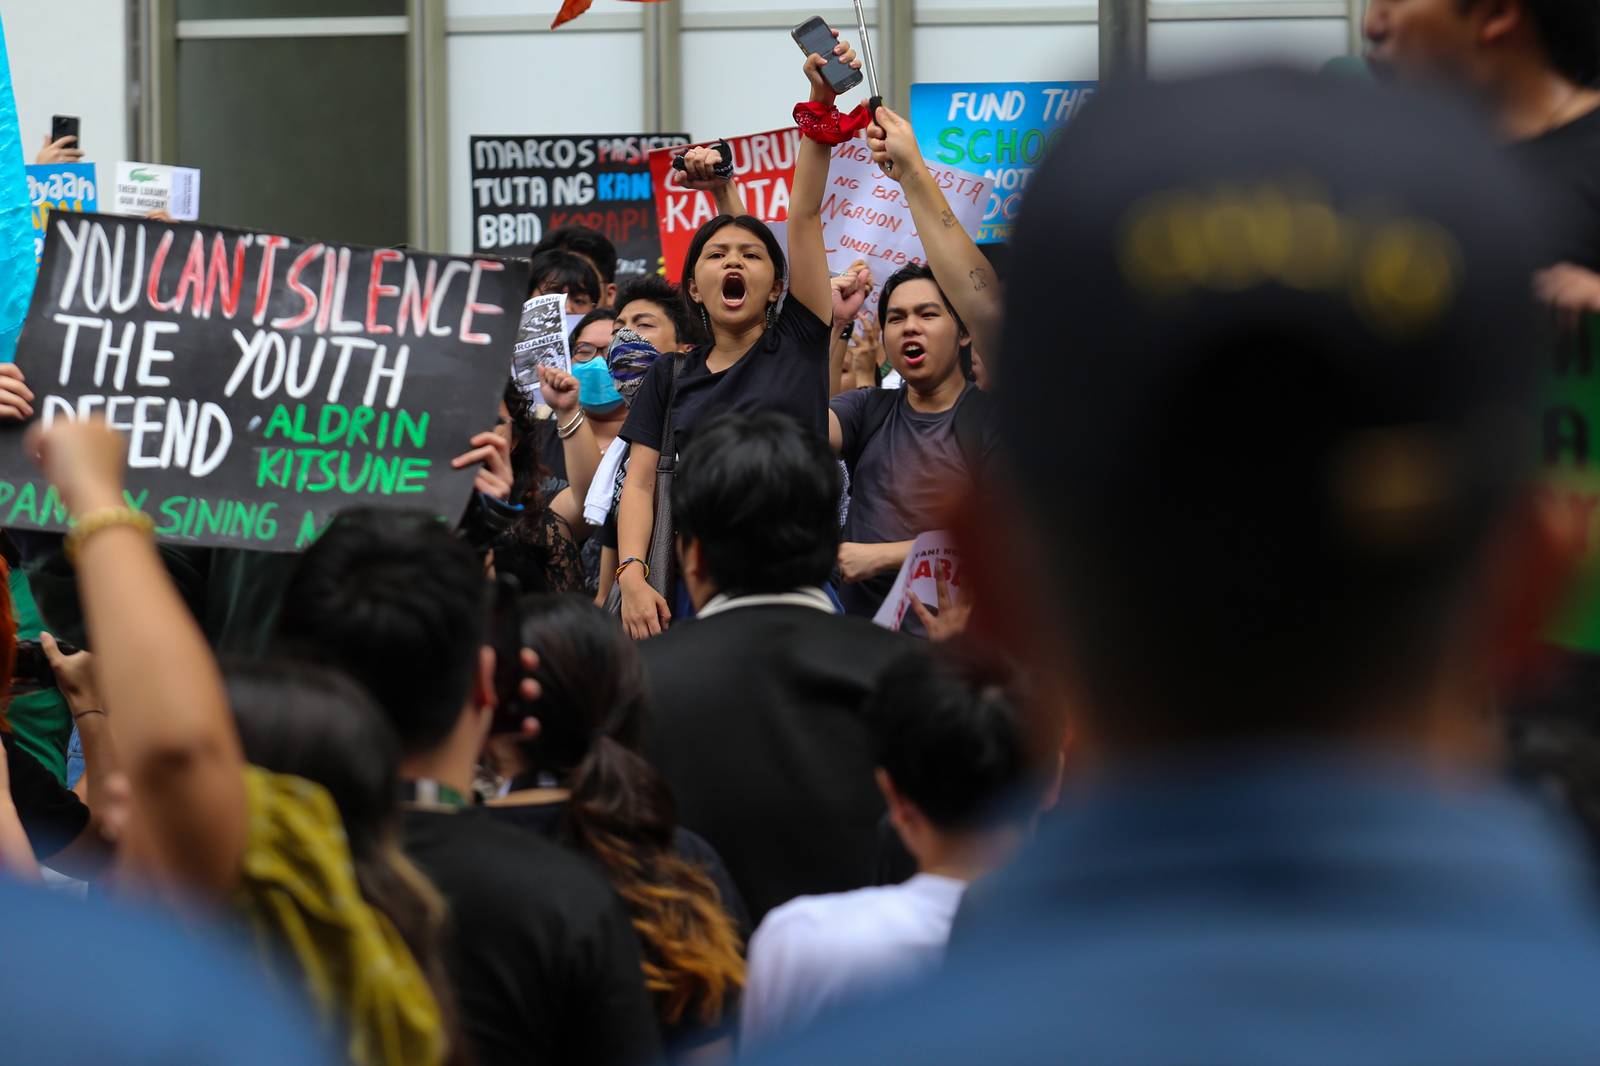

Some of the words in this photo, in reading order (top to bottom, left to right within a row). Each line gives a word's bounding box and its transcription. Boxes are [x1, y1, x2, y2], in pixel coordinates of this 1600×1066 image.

[948, 90, 1025, 122] FUND
[475, 139, 596, 170] MARCOS
[473, 175, 548, 207] TUTA
[553, 172, 596, 206] NG
[833, 175, 861, 191] NG
[478, 212, 543, 250] BBM
[819, 192, 903, 233] NGAYON
[57, 219, 145, 313] YOU
[148, 229, 289, 326] CAN'T
[271, 242, 505, 346] SILENCE
[53, 313, 180, 391] THE
[223, 328, 410, 409] YOUTH
[264, 404, 430, 449] ALDRIN
[256, 447, 432, 494] KITSUNE
[154, 495, 279, 541] SINING
